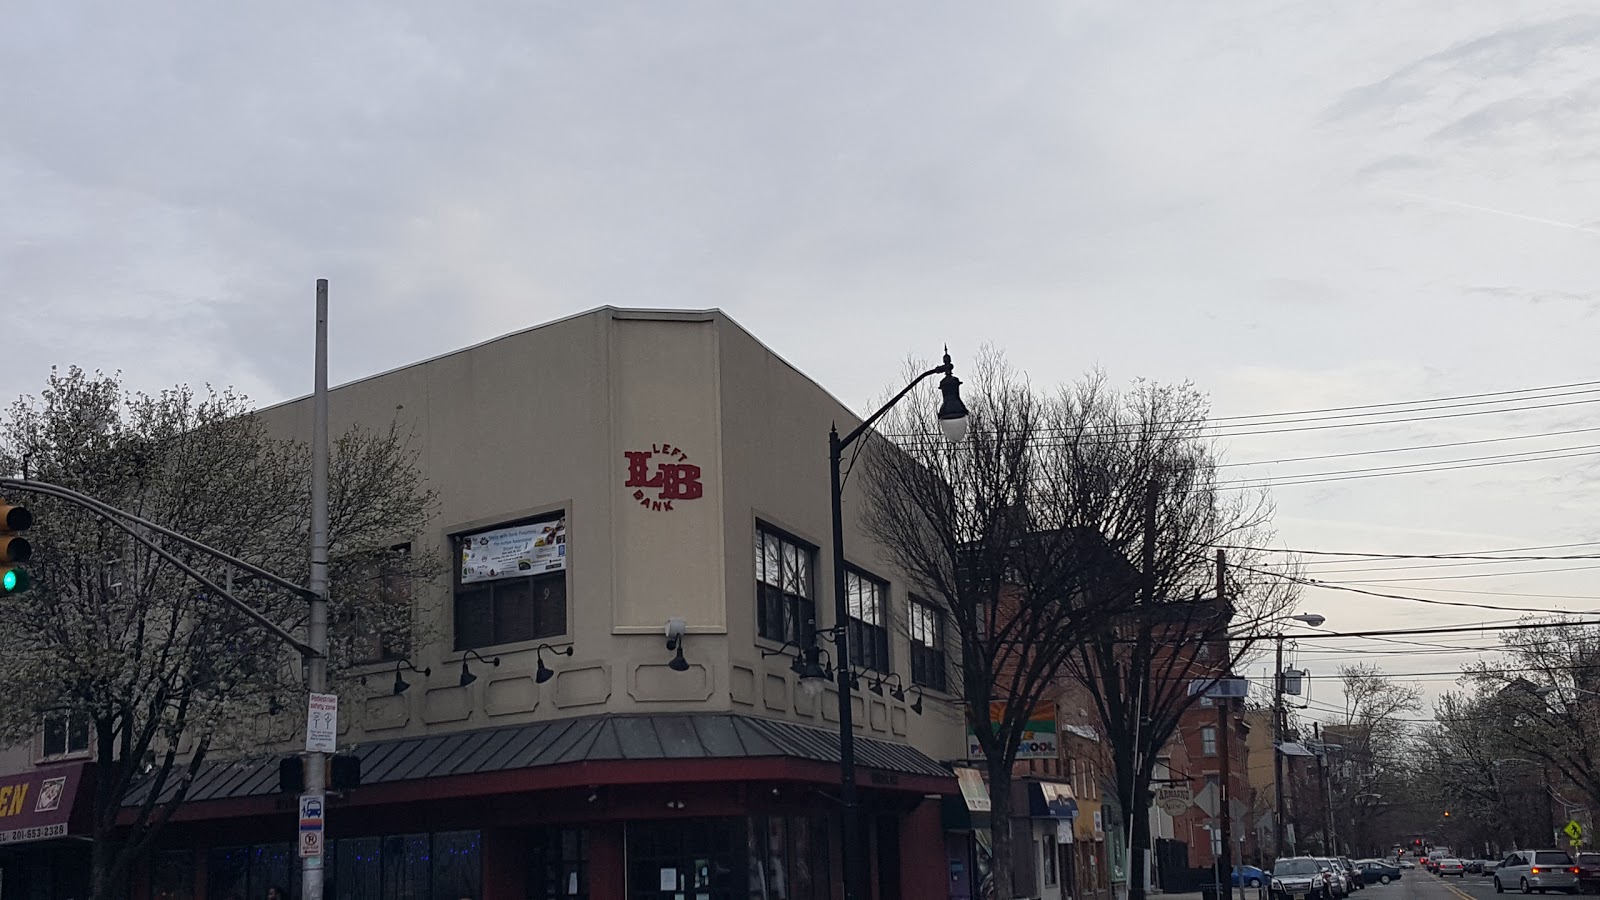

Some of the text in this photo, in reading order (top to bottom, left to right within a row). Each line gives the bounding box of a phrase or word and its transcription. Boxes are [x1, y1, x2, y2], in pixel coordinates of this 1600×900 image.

[653, 444, 687, 462] LEFT
[624, 452, 702, 499] LB
[633, 489, 674, 511] BANK
